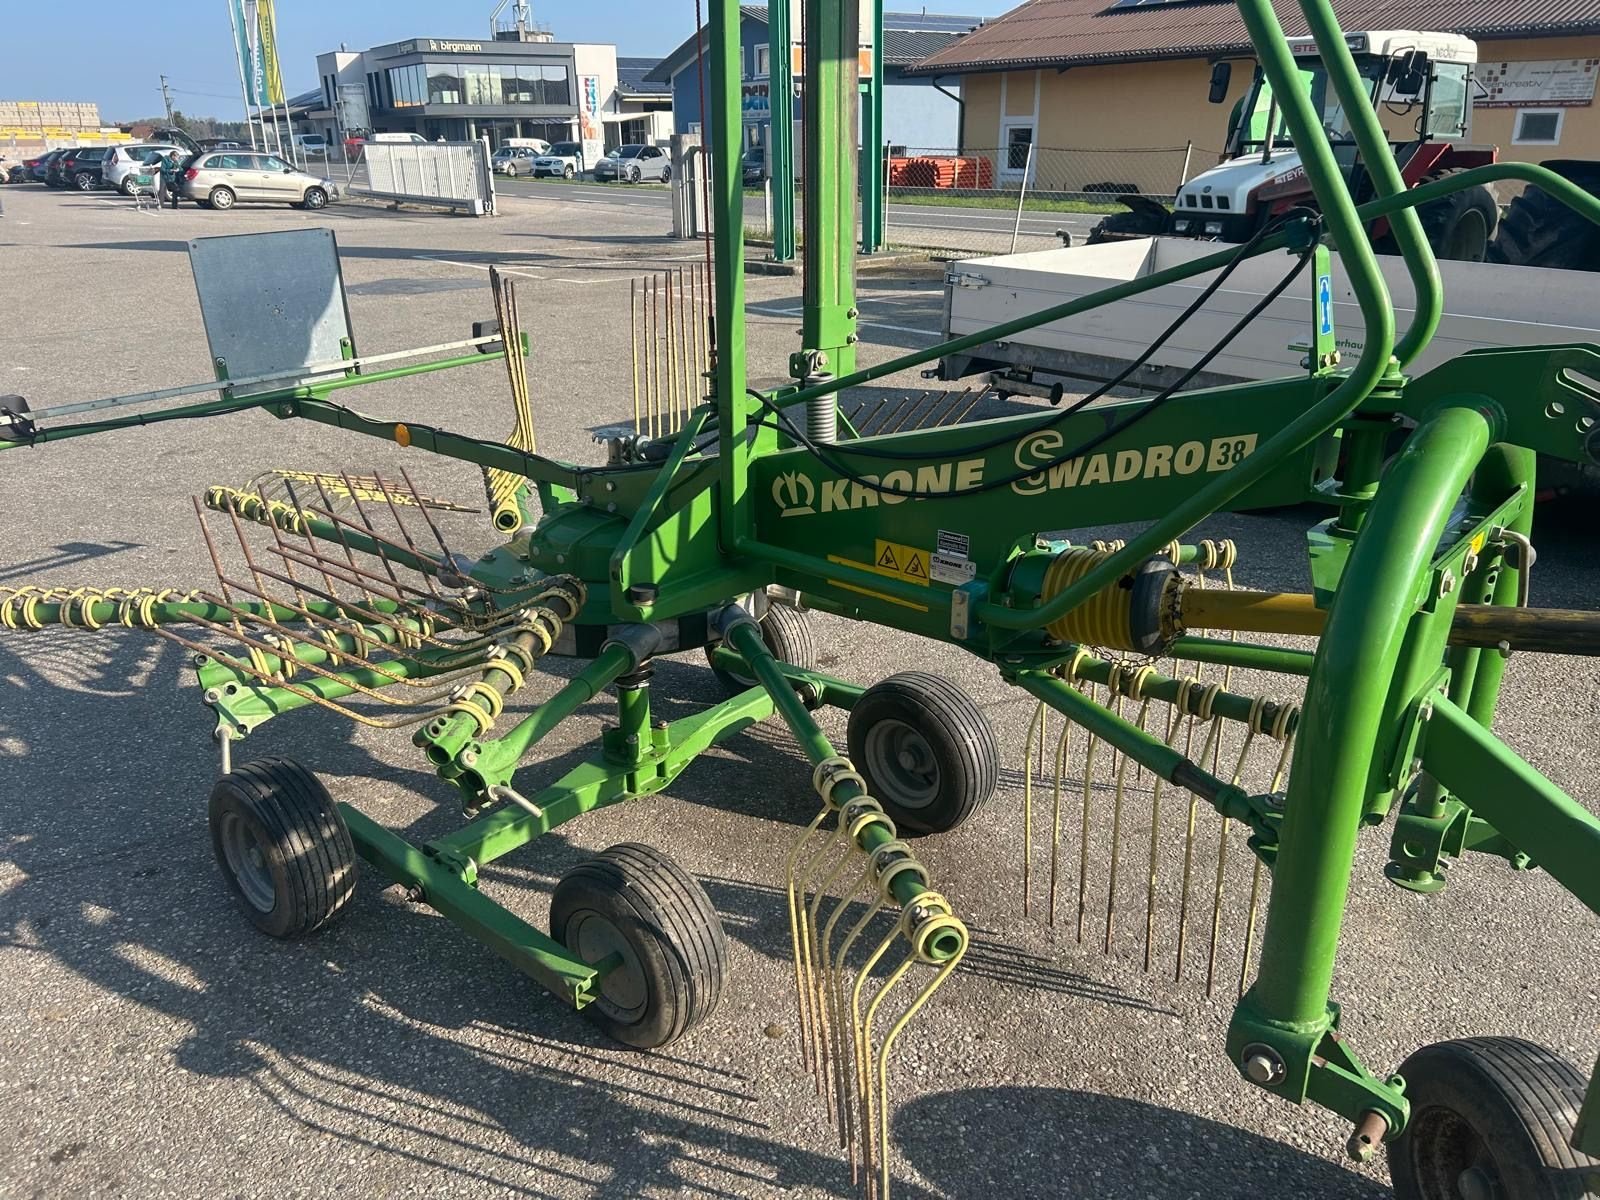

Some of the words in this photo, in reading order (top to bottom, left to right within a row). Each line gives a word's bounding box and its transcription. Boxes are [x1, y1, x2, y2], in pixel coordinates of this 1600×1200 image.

[440, 41, 481, 52] birgmann
[1294, 44, 1316, 52] STE
[1274, 166, 1304, 184] STEYR
[1011, 430, 1205, 495] SWADRO
[1216, 439, 1247, 467] 38
[821, 458, 986, 513] KRONE
